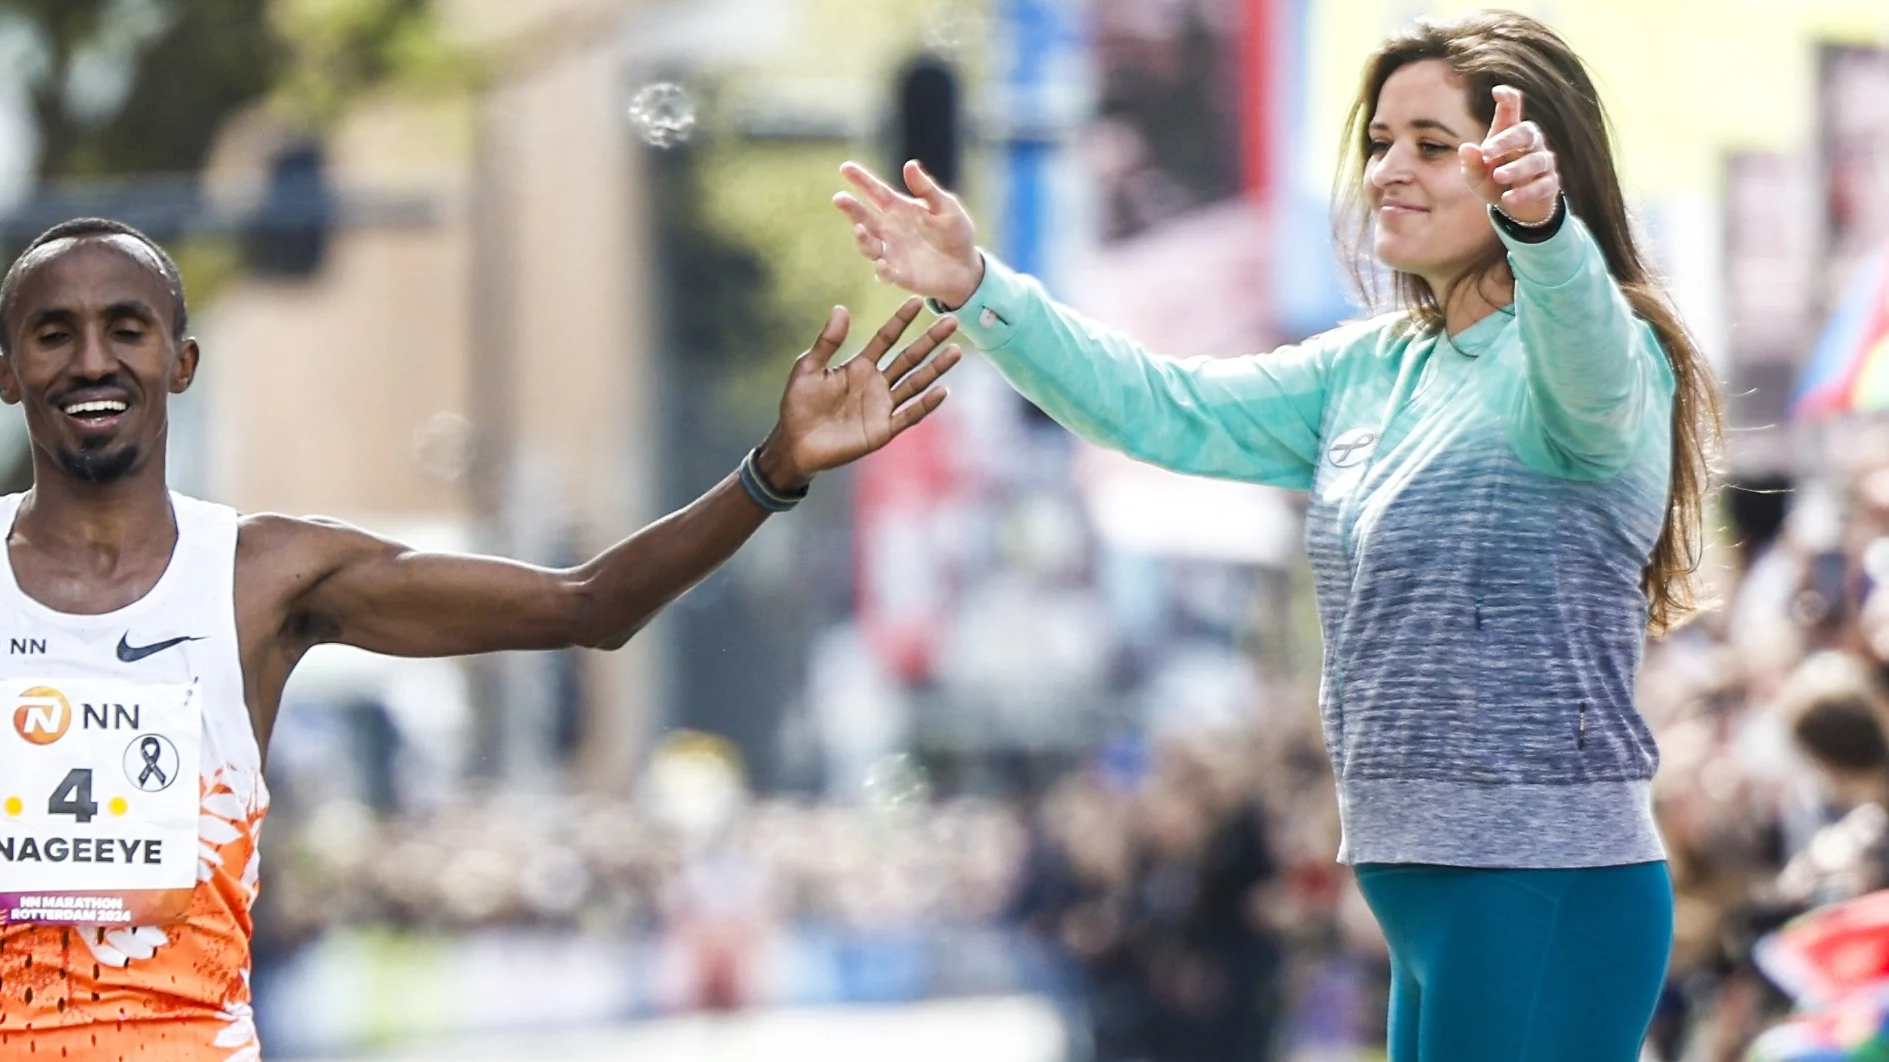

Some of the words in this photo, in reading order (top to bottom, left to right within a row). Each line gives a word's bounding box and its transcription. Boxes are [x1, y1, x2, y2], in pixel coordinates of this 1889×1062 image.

[10, 638, 47, 655] NN
[82, 703, 140, 731] NN
[47, 767, 99, 824] 4
[20, 896, 41, 908] NN
[42, 896, 123, 909] MARATHON
[11, 908, 96, 921] ROTTERDAM
[96, 910, 131, 922] 2024
